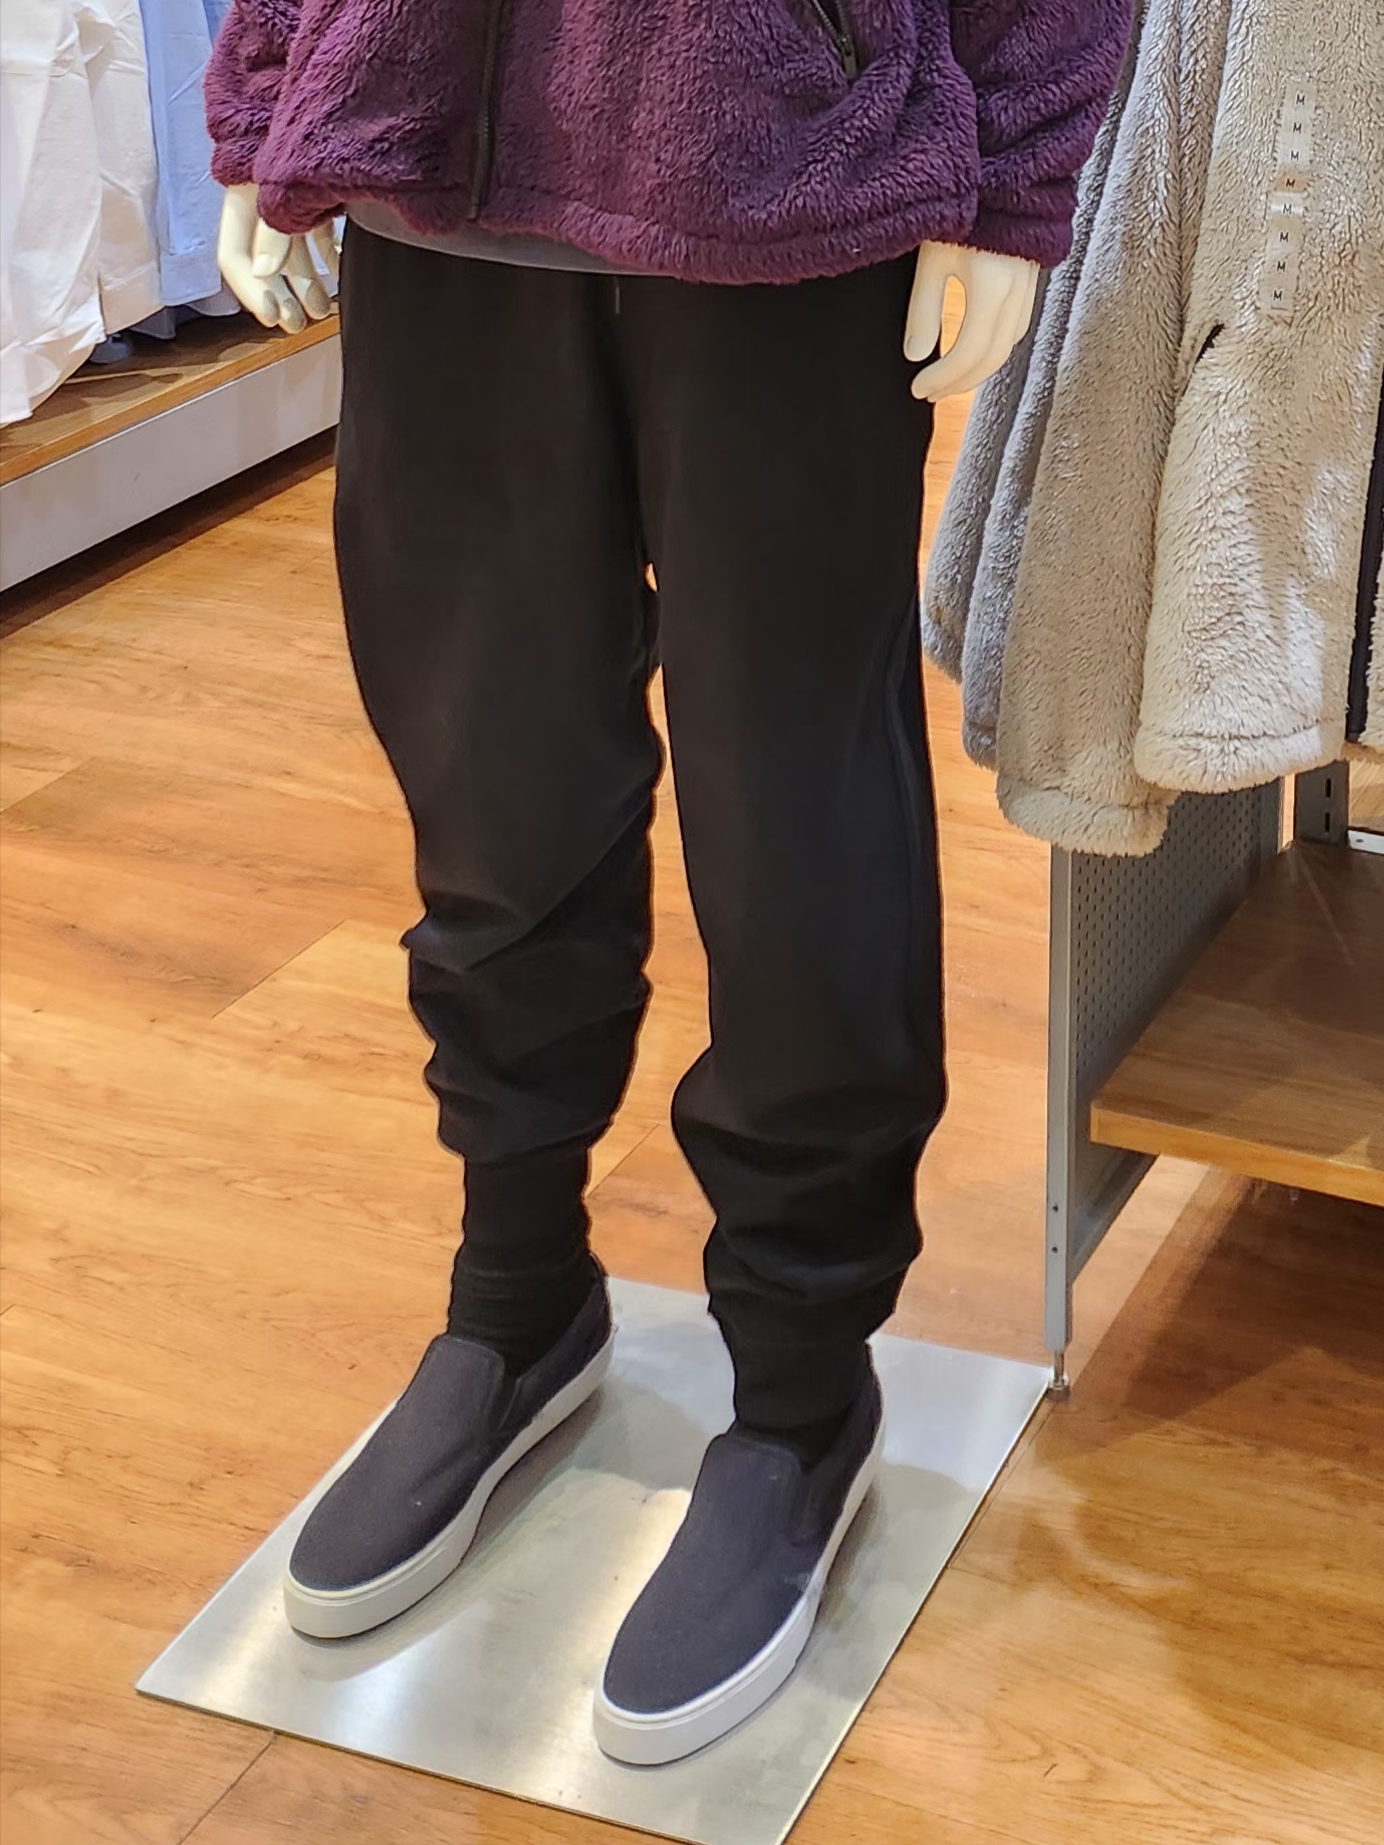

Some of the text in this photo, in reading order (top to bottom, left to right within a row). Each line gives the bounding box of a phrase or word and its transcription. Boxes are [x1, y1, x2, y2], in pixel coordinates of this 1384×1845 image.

[1273, 94, 1306, 301] M M M M M M M M
